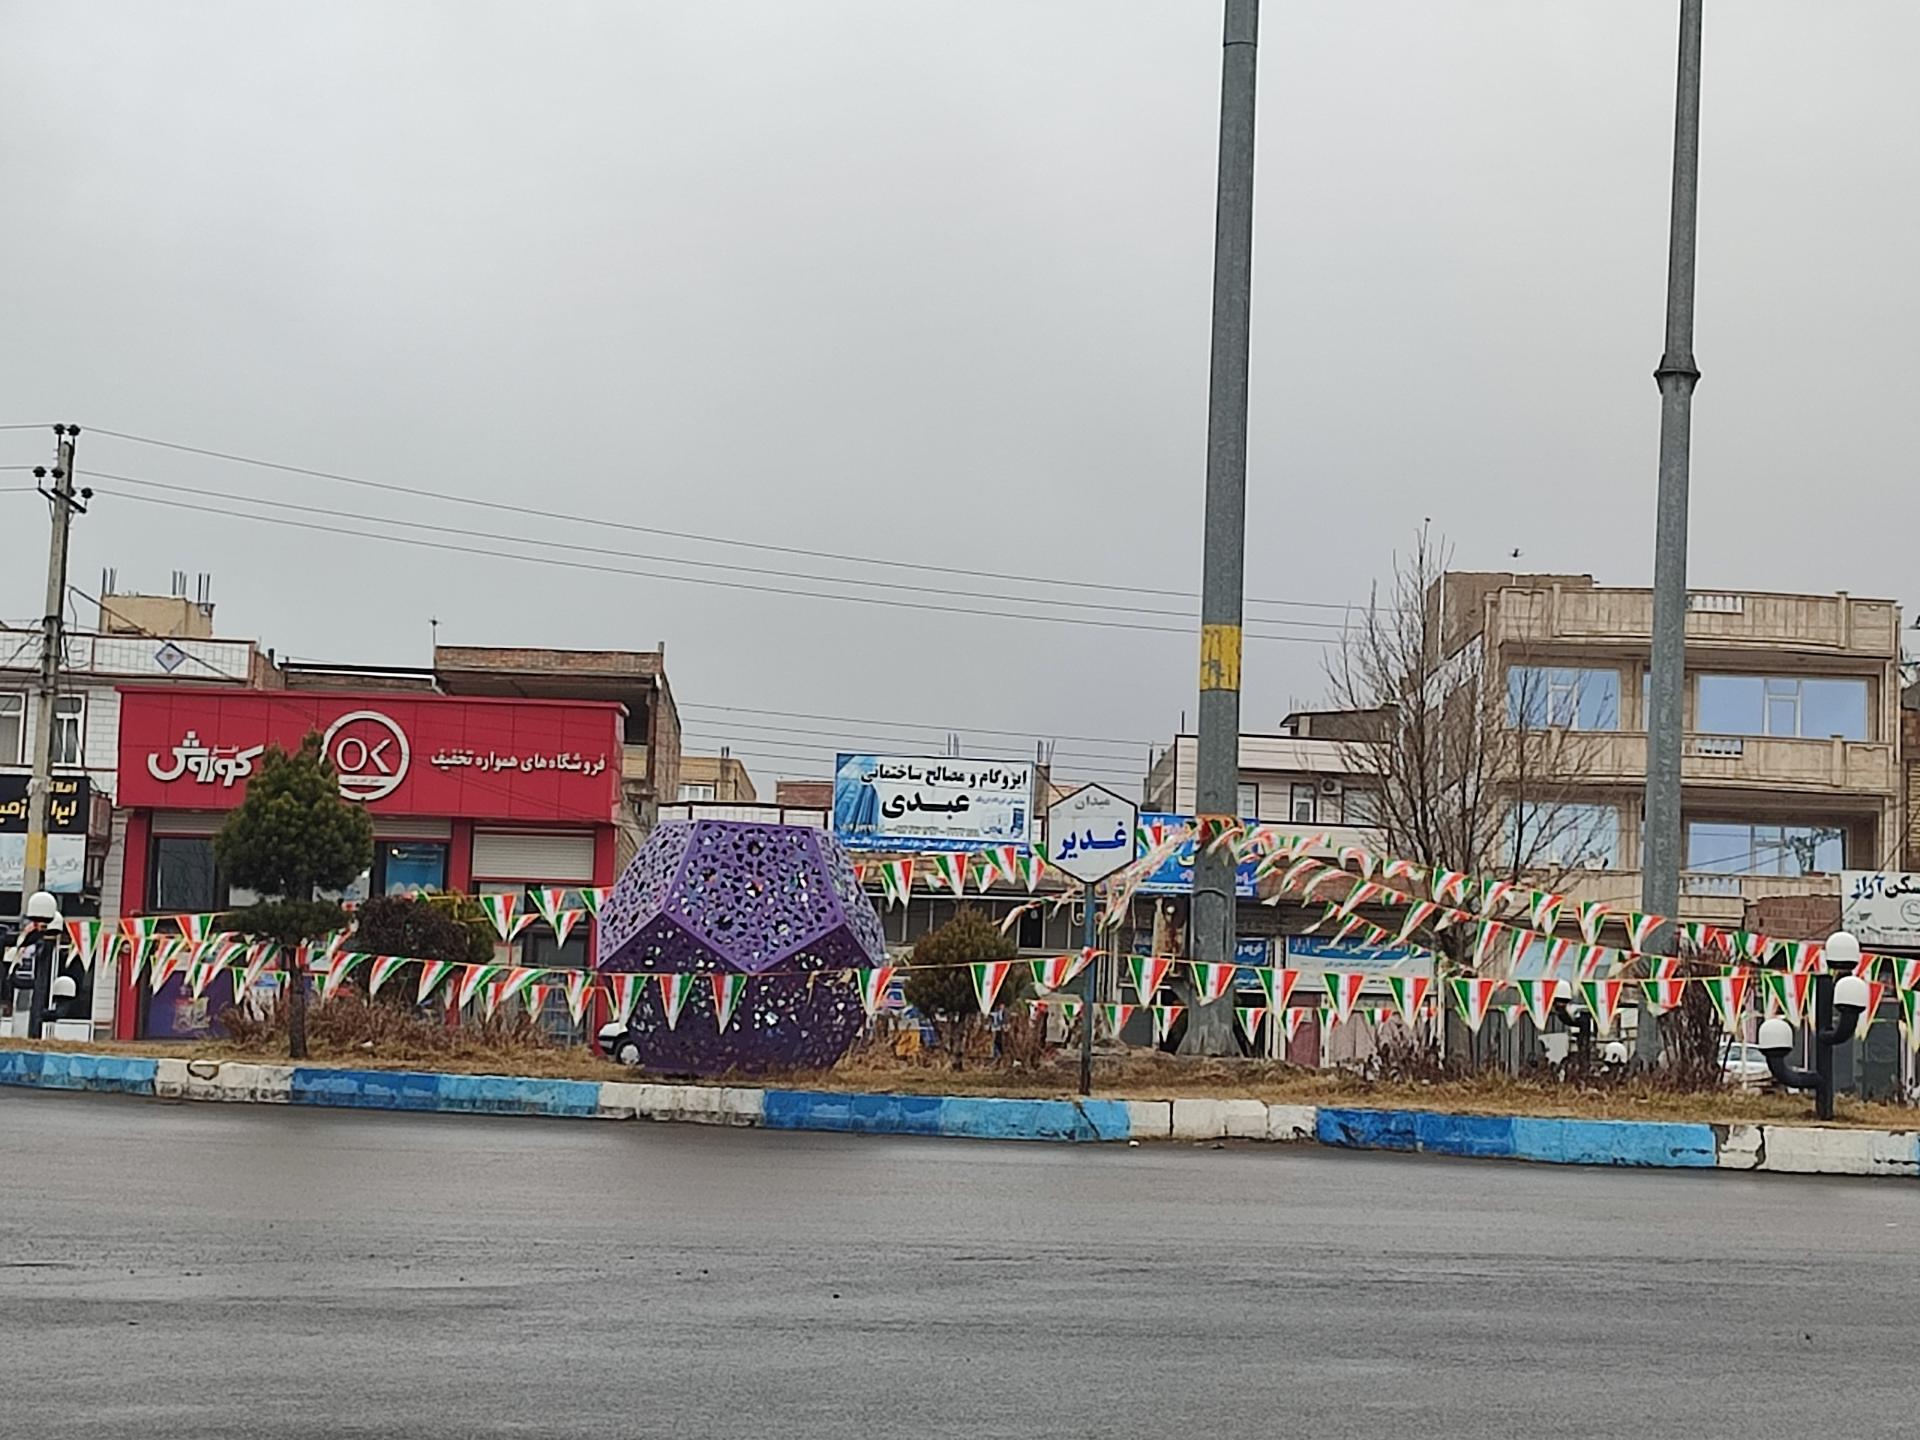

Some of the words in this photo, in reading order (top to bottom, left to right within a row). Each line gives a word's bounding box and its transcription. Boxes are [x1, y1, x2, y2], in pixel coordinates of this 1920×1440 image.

[336, 737, 393, 772] OK
[50, 800, 77, 825] ایرا
[881, 791, 970, 819] عبدی
[1075, 795, 1111, 810] میدان
[1055, 821, 1127, 860] غدیر
